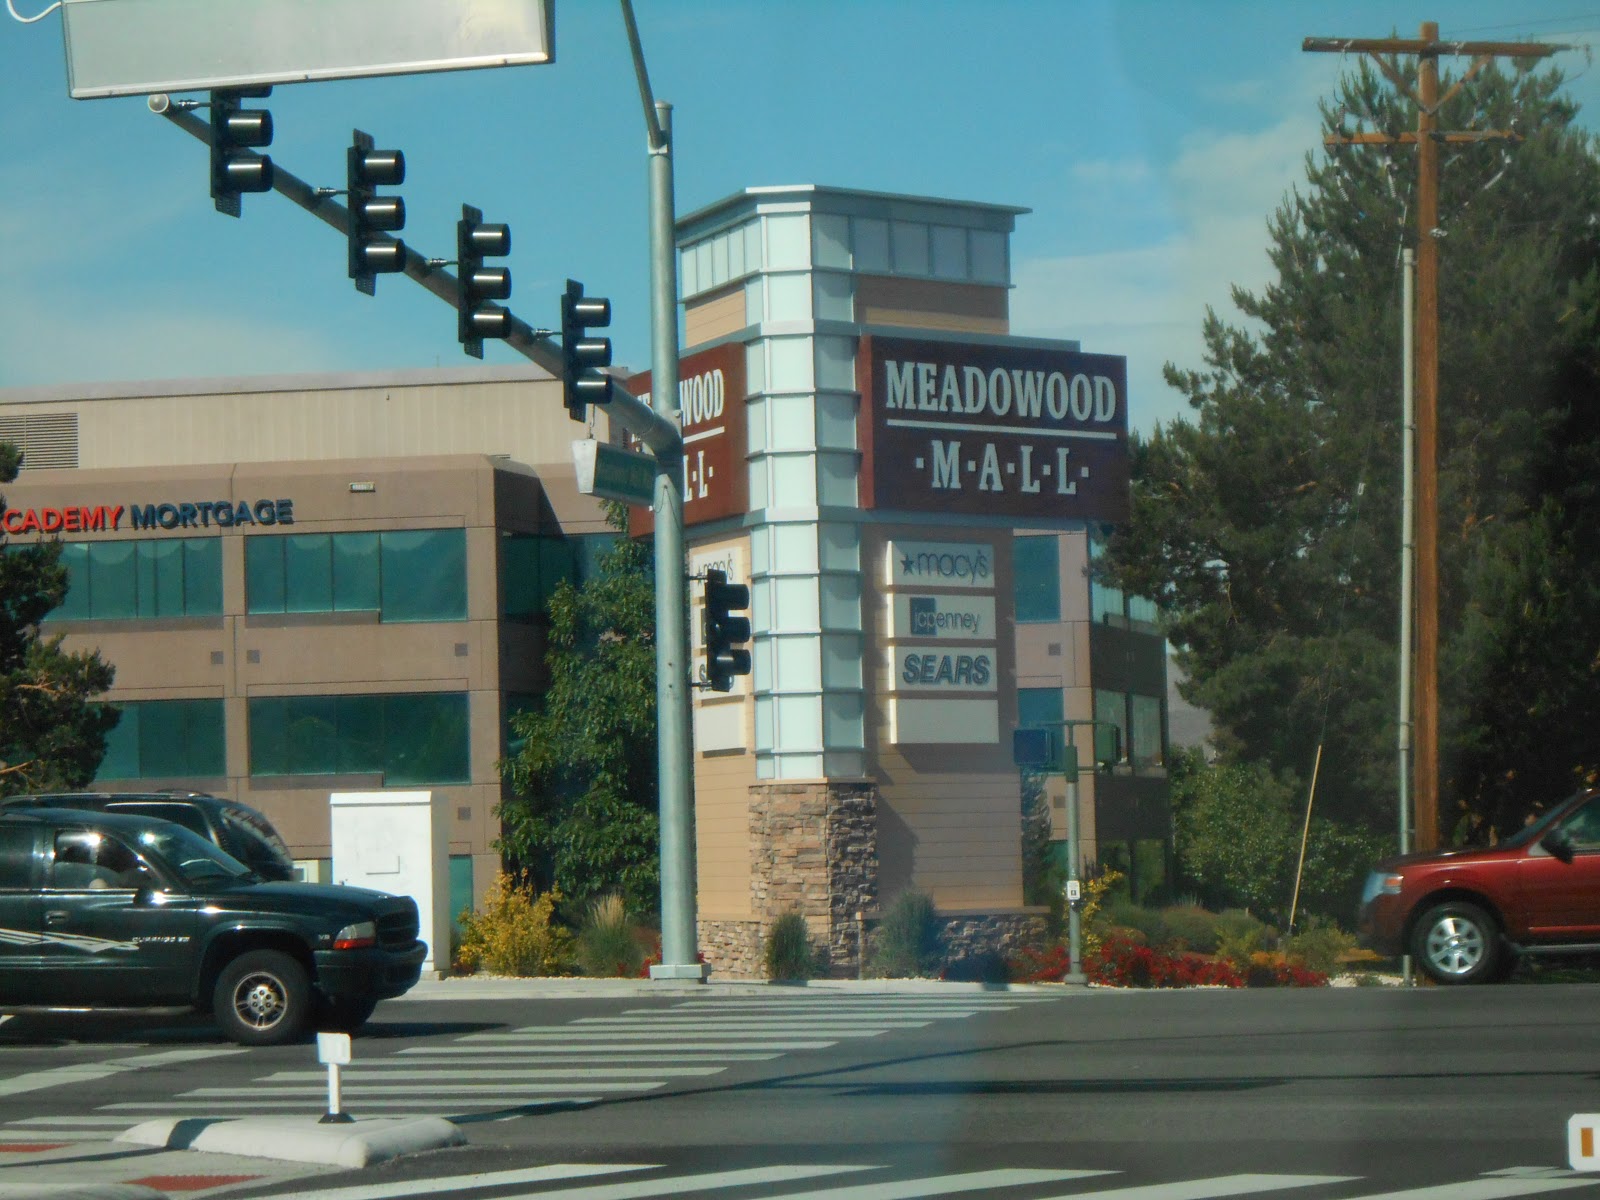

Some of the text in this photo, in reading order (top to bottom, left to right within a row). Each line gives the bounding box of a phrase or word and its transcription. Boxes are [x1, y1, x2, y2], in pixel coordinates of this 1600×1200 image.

[885, 360, 1116, 422] MEADOWOOD
[0, 499, 293, 533] CADEMY MORTGAGE
[918, 550, 989, 584] macy's
[903, 653, 990, 686] SEARS
